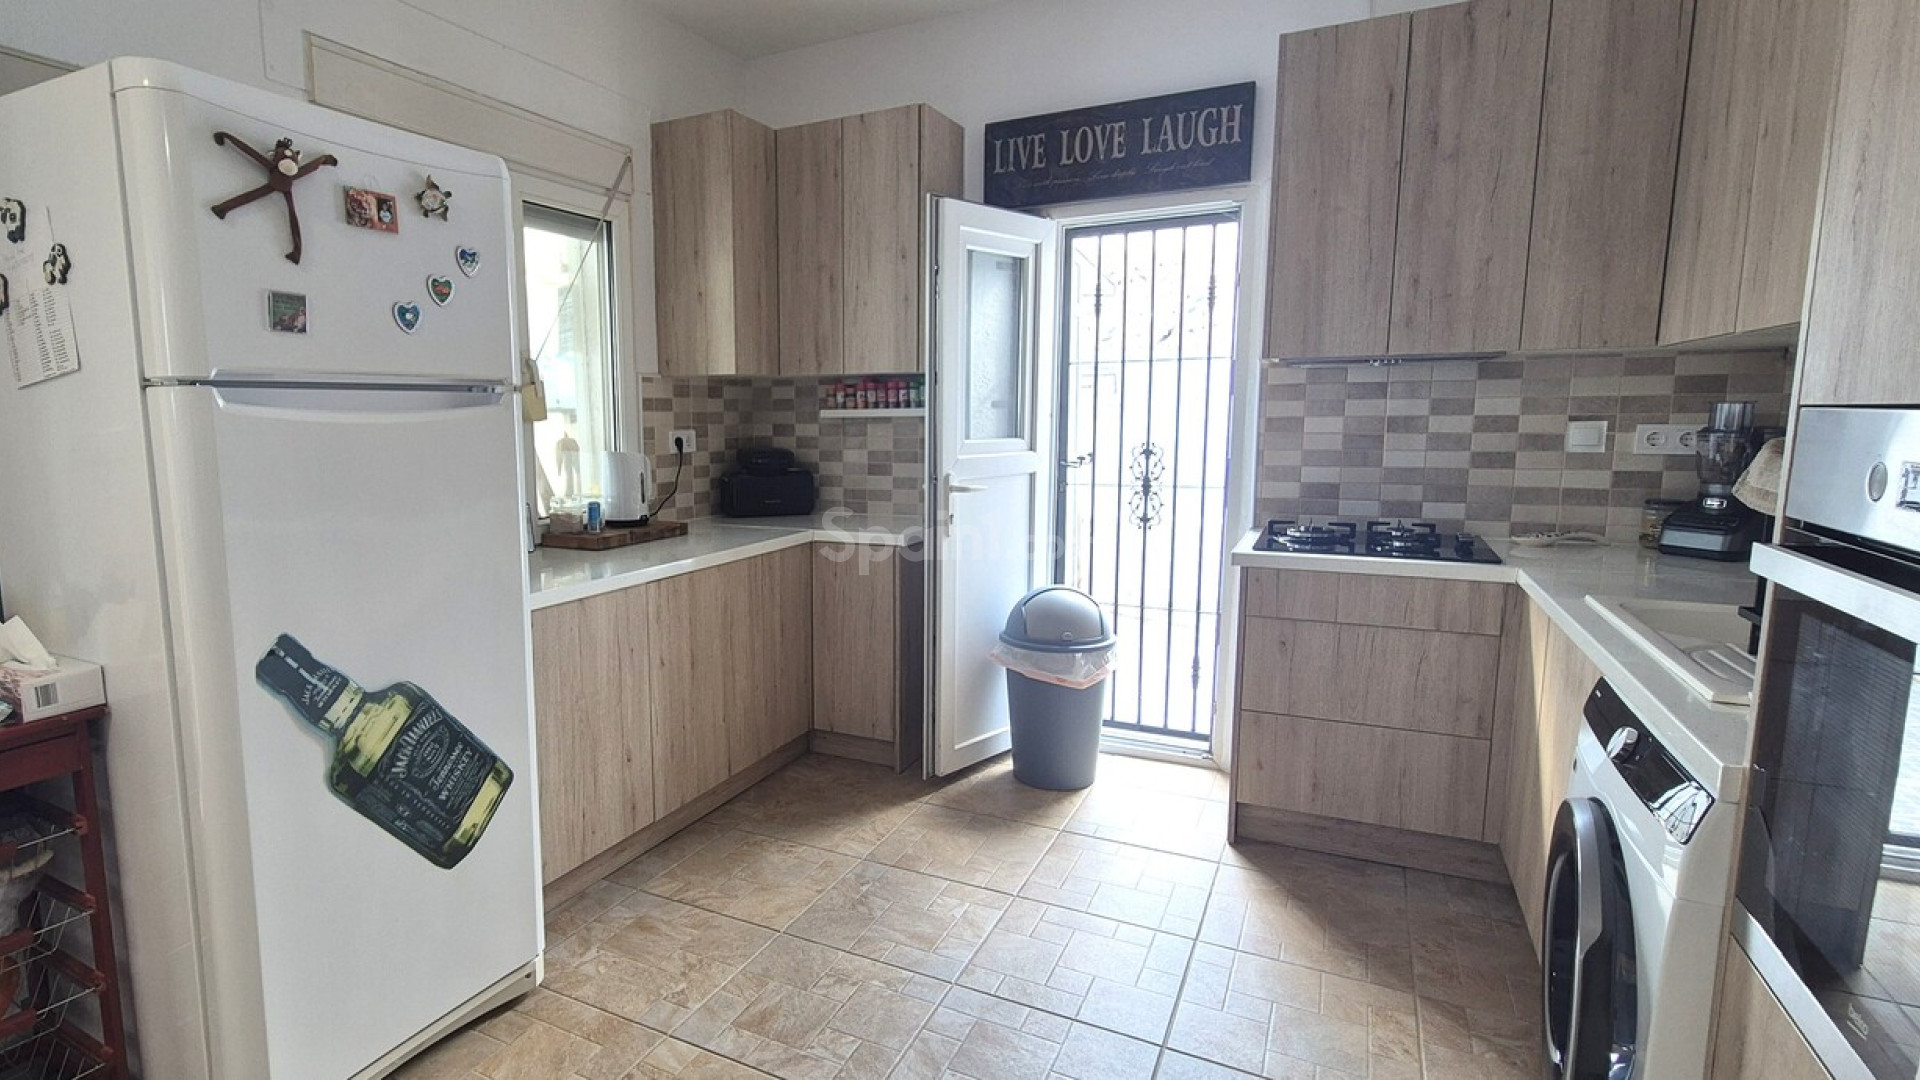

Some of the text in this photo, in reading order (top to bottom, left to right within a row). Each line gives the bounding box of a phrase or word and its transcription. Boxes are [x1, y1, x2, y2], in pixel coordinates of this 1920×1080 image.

[994, 104, 1243, 174] LIVE LOVE LAUGH
